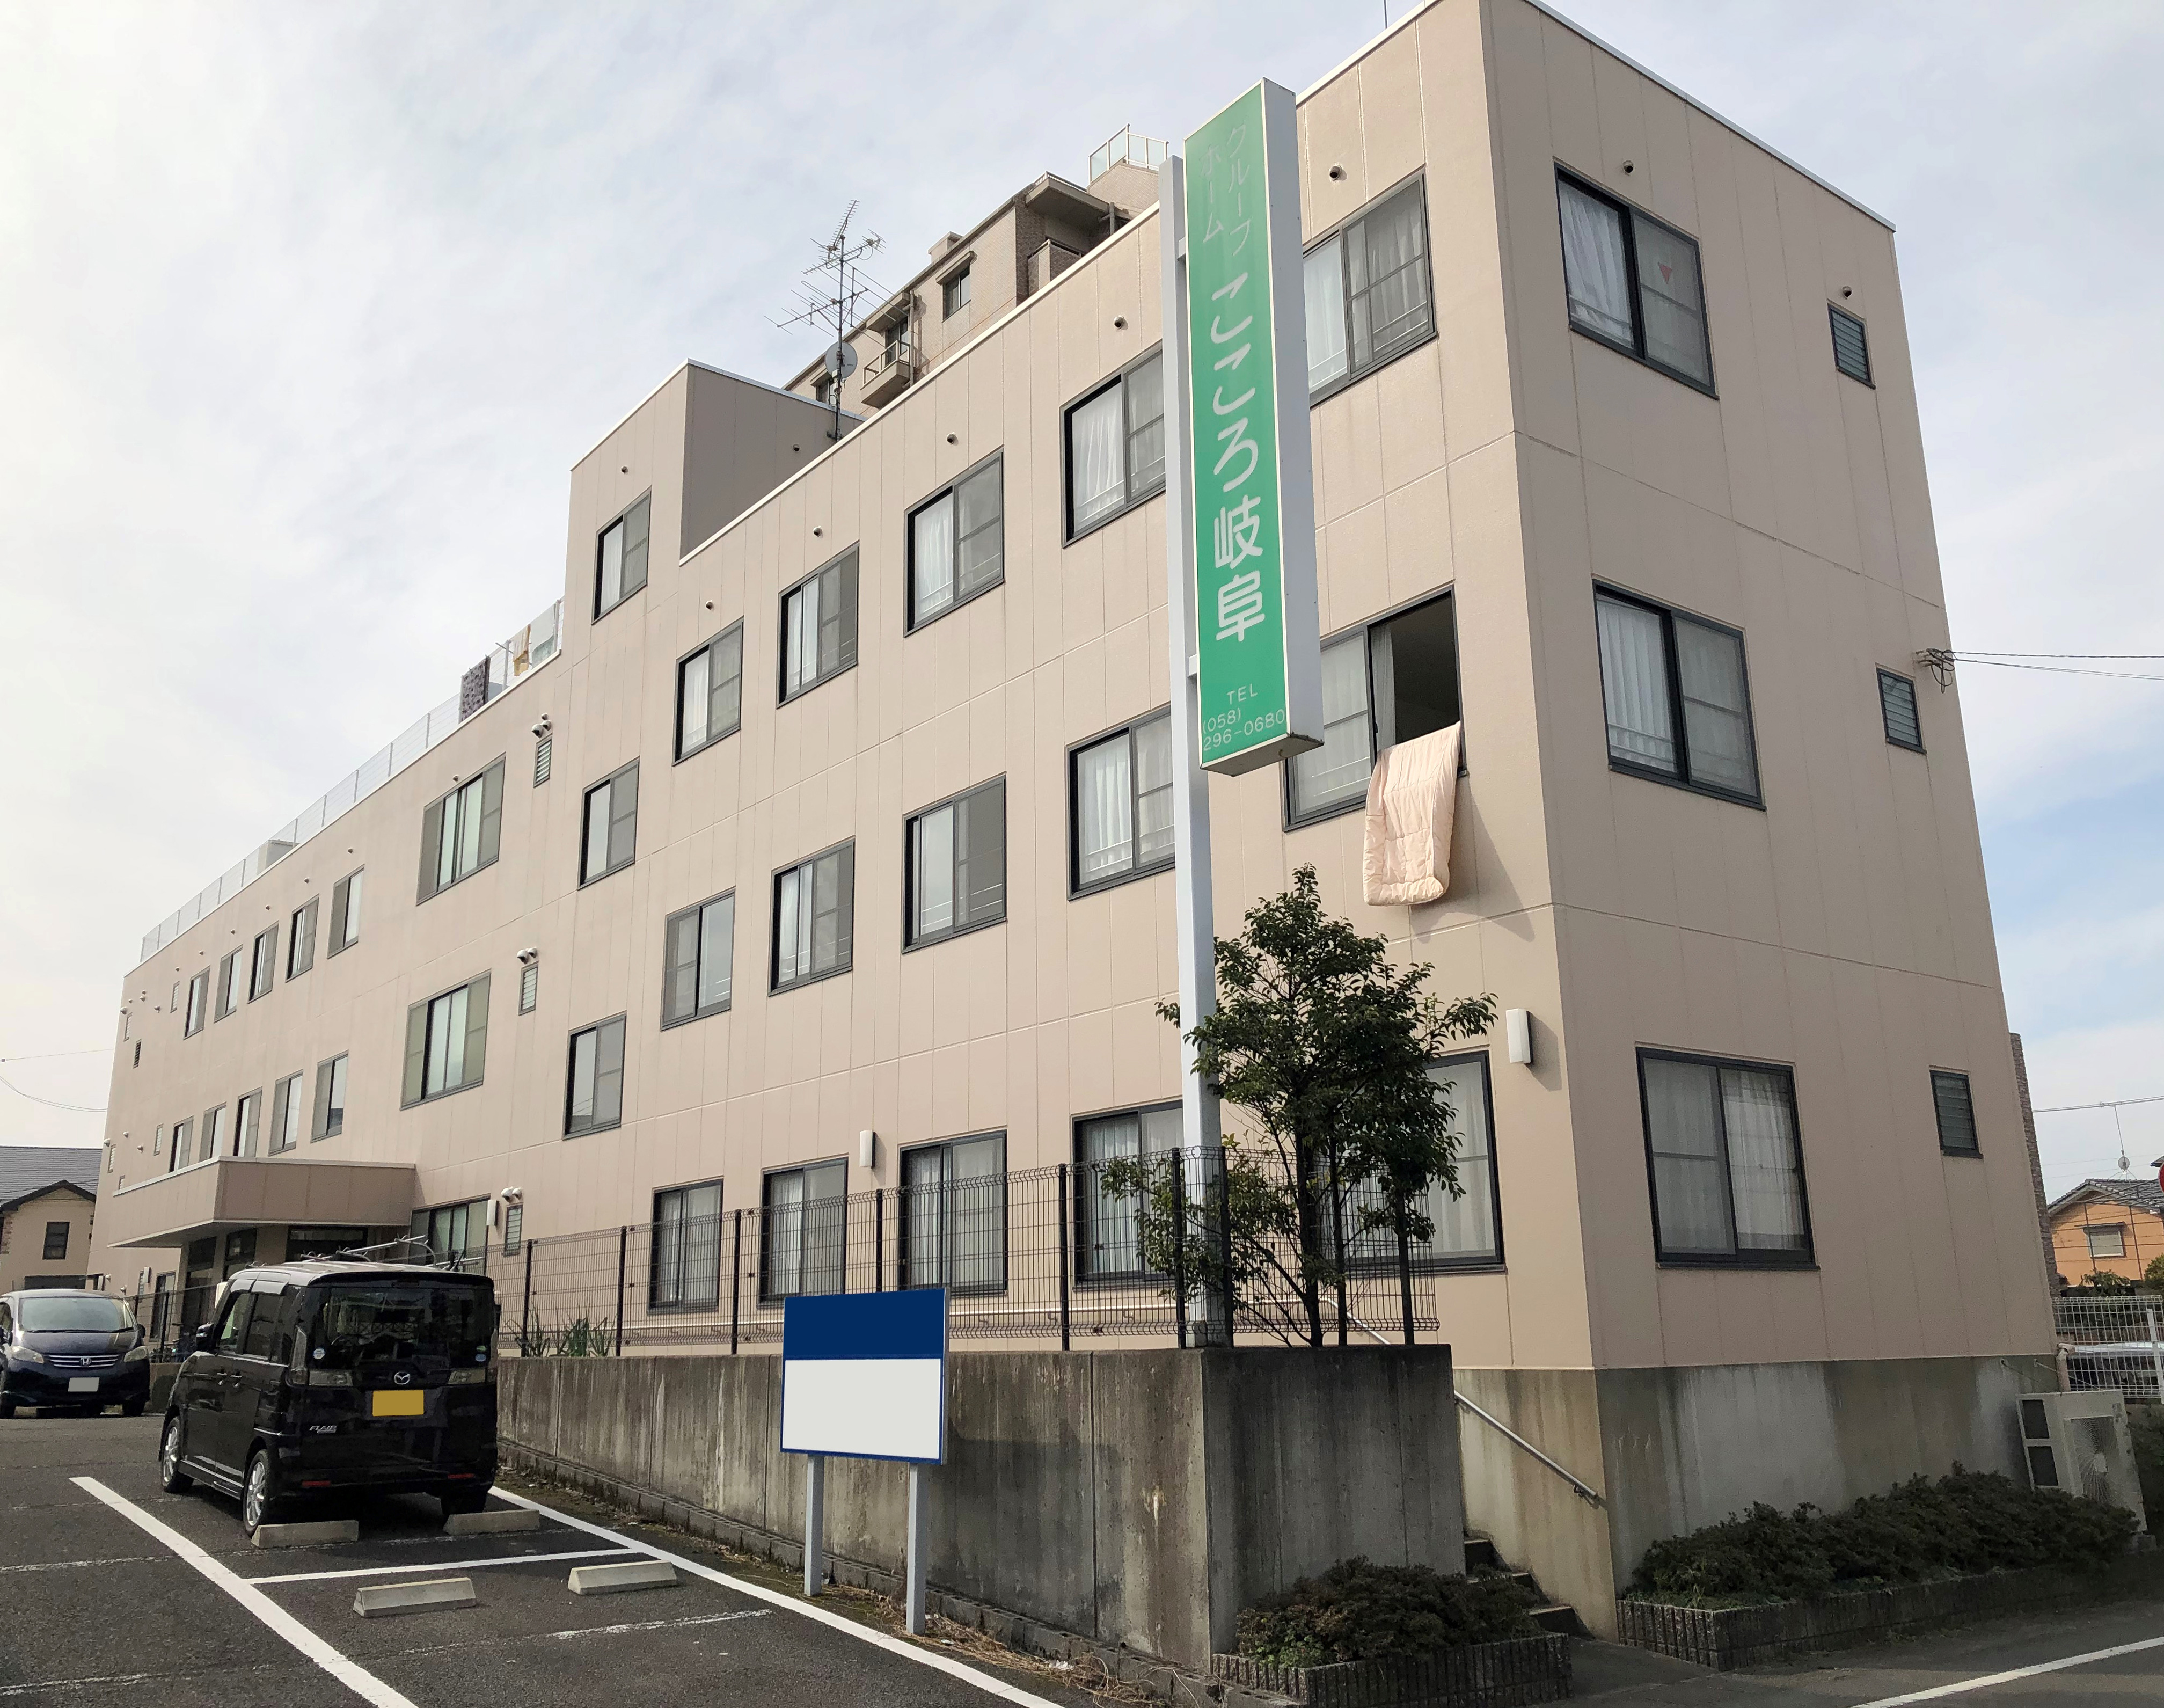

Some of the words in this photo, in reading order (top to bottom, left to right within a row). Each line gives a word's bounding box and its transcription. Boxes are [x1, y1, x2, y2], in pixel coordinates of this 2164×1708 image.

[1210, 272, 1266, 642] こころ岐阜
[1226, 683, 1258, 705] TEL
[1203, 707, 1241, 734] (058)
[1204, 709, 1285, 751] 296-0680
